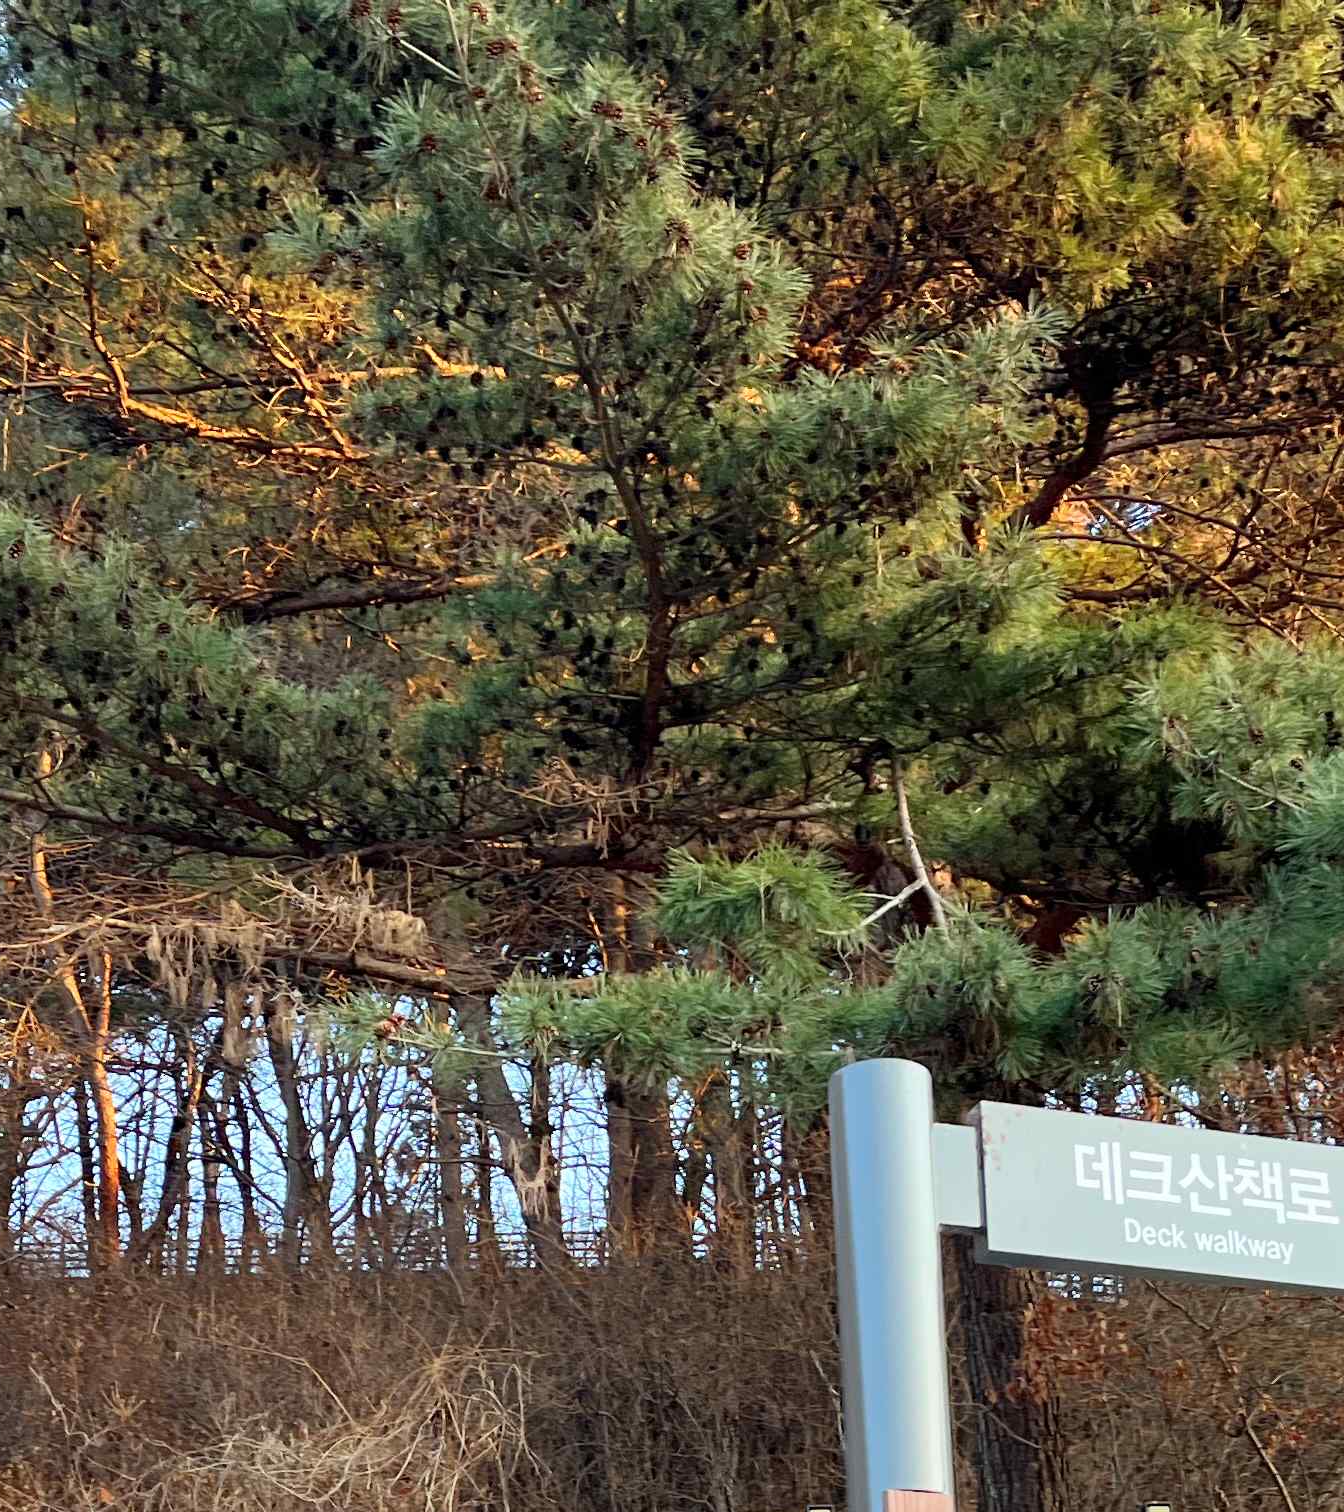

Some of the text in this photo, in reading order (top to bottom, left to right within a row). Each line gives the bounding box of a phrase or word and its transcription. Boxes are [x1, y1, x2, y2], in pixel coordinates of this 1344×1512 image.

[1074, 1142, 1340, 1225] 데크산책로
[1124, 1218, 1294, 1265] Deck walkway
